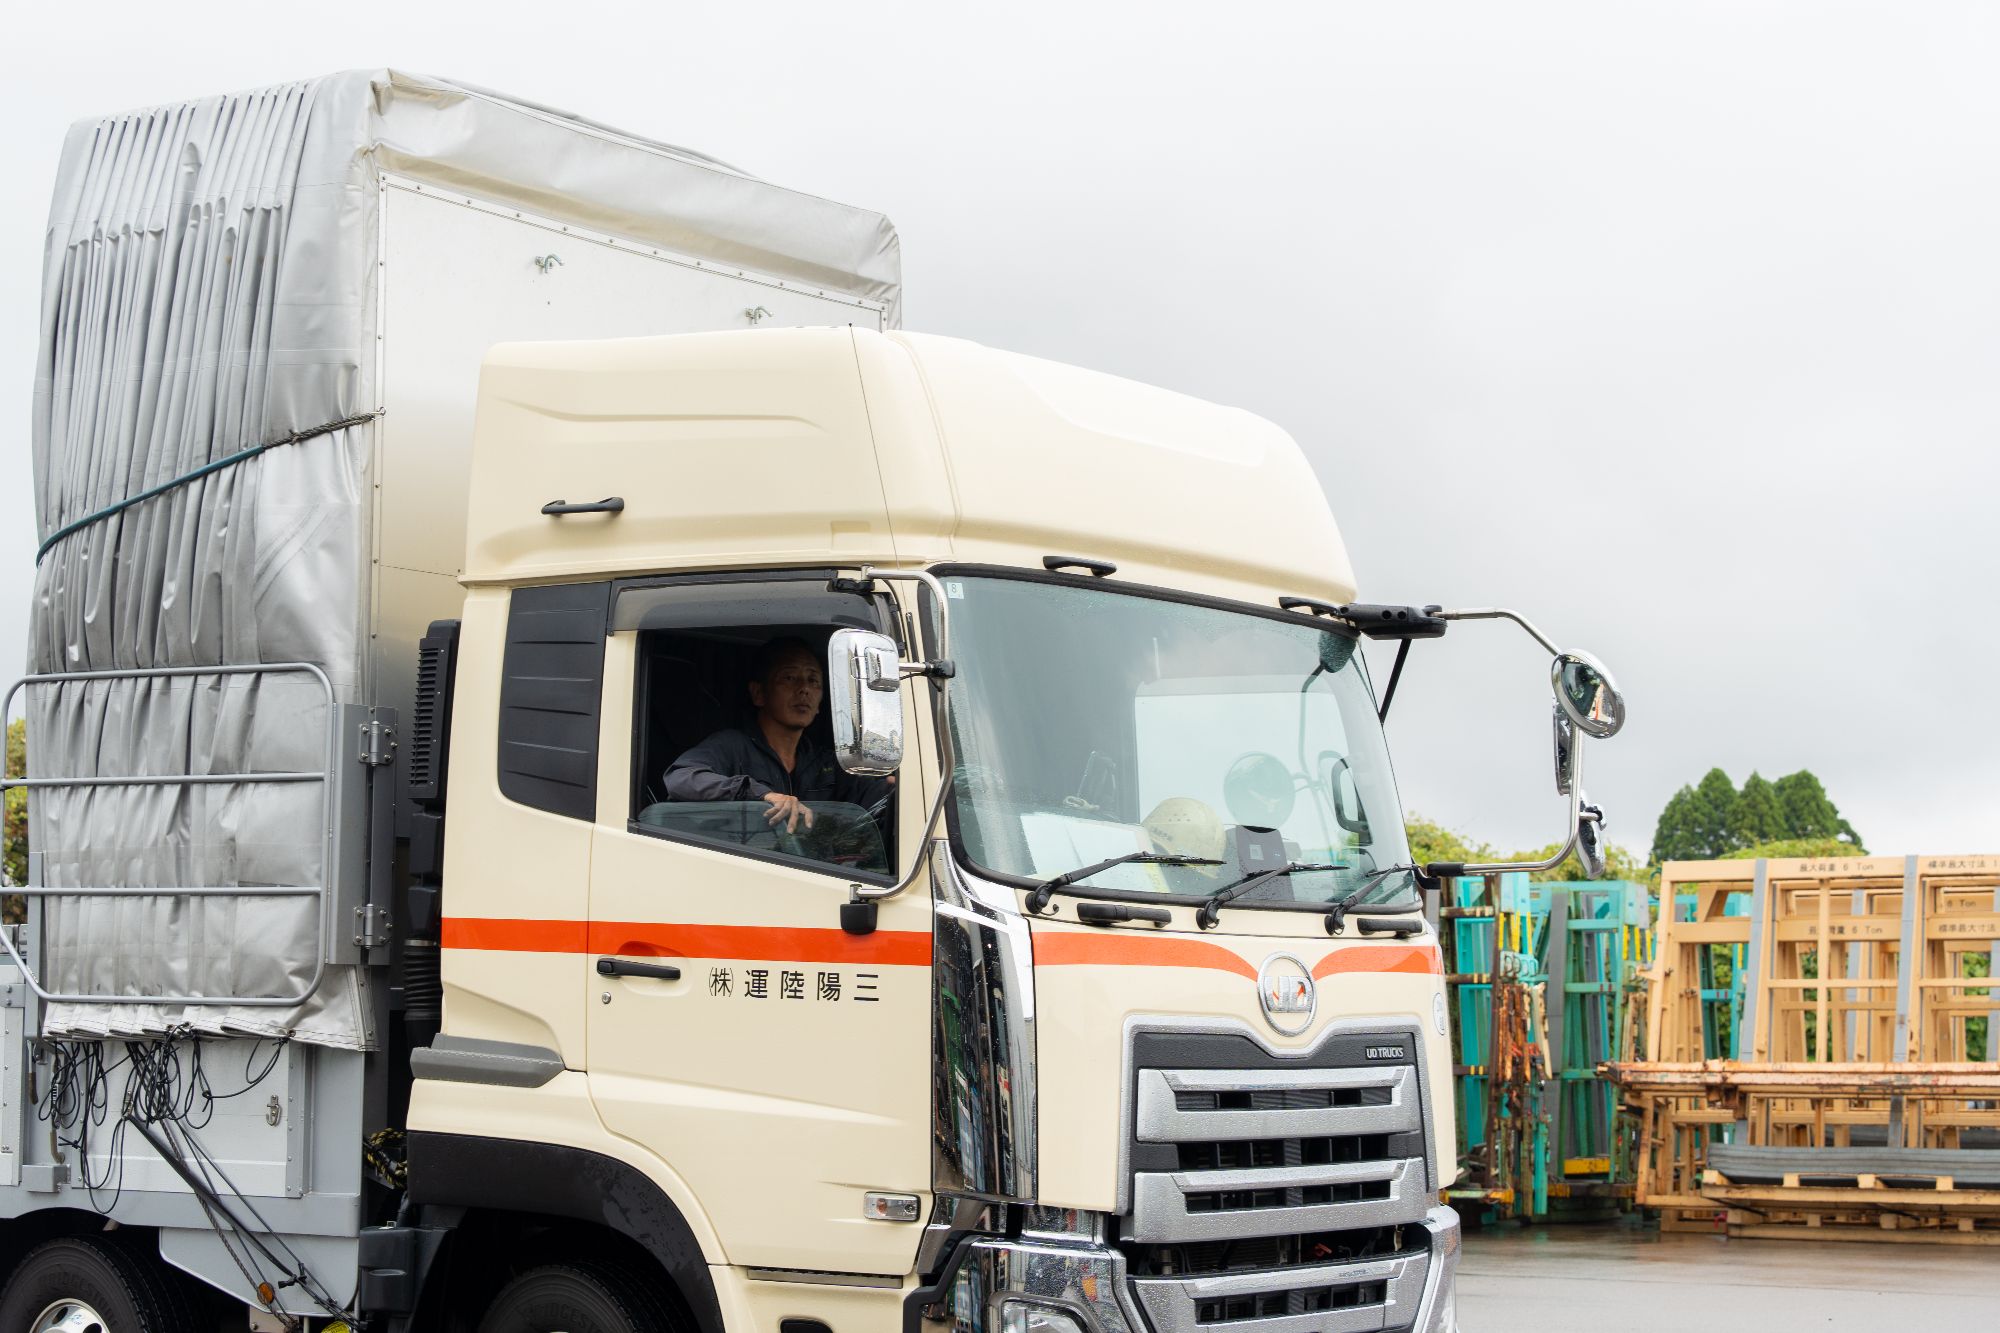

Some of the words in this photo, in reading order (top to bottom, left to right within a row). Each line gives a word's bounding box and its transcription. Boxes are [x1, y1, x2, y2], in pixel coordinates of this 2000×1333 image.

[1857, 862, 1874, 871] Ton
[1959, 899, 1976, 907] Ton
[1865, 925, 1883, 934] Ton
[1366, 1048, 1378, 1059] UD
[1377, 1046, 1404, 1058] TRUCKS
